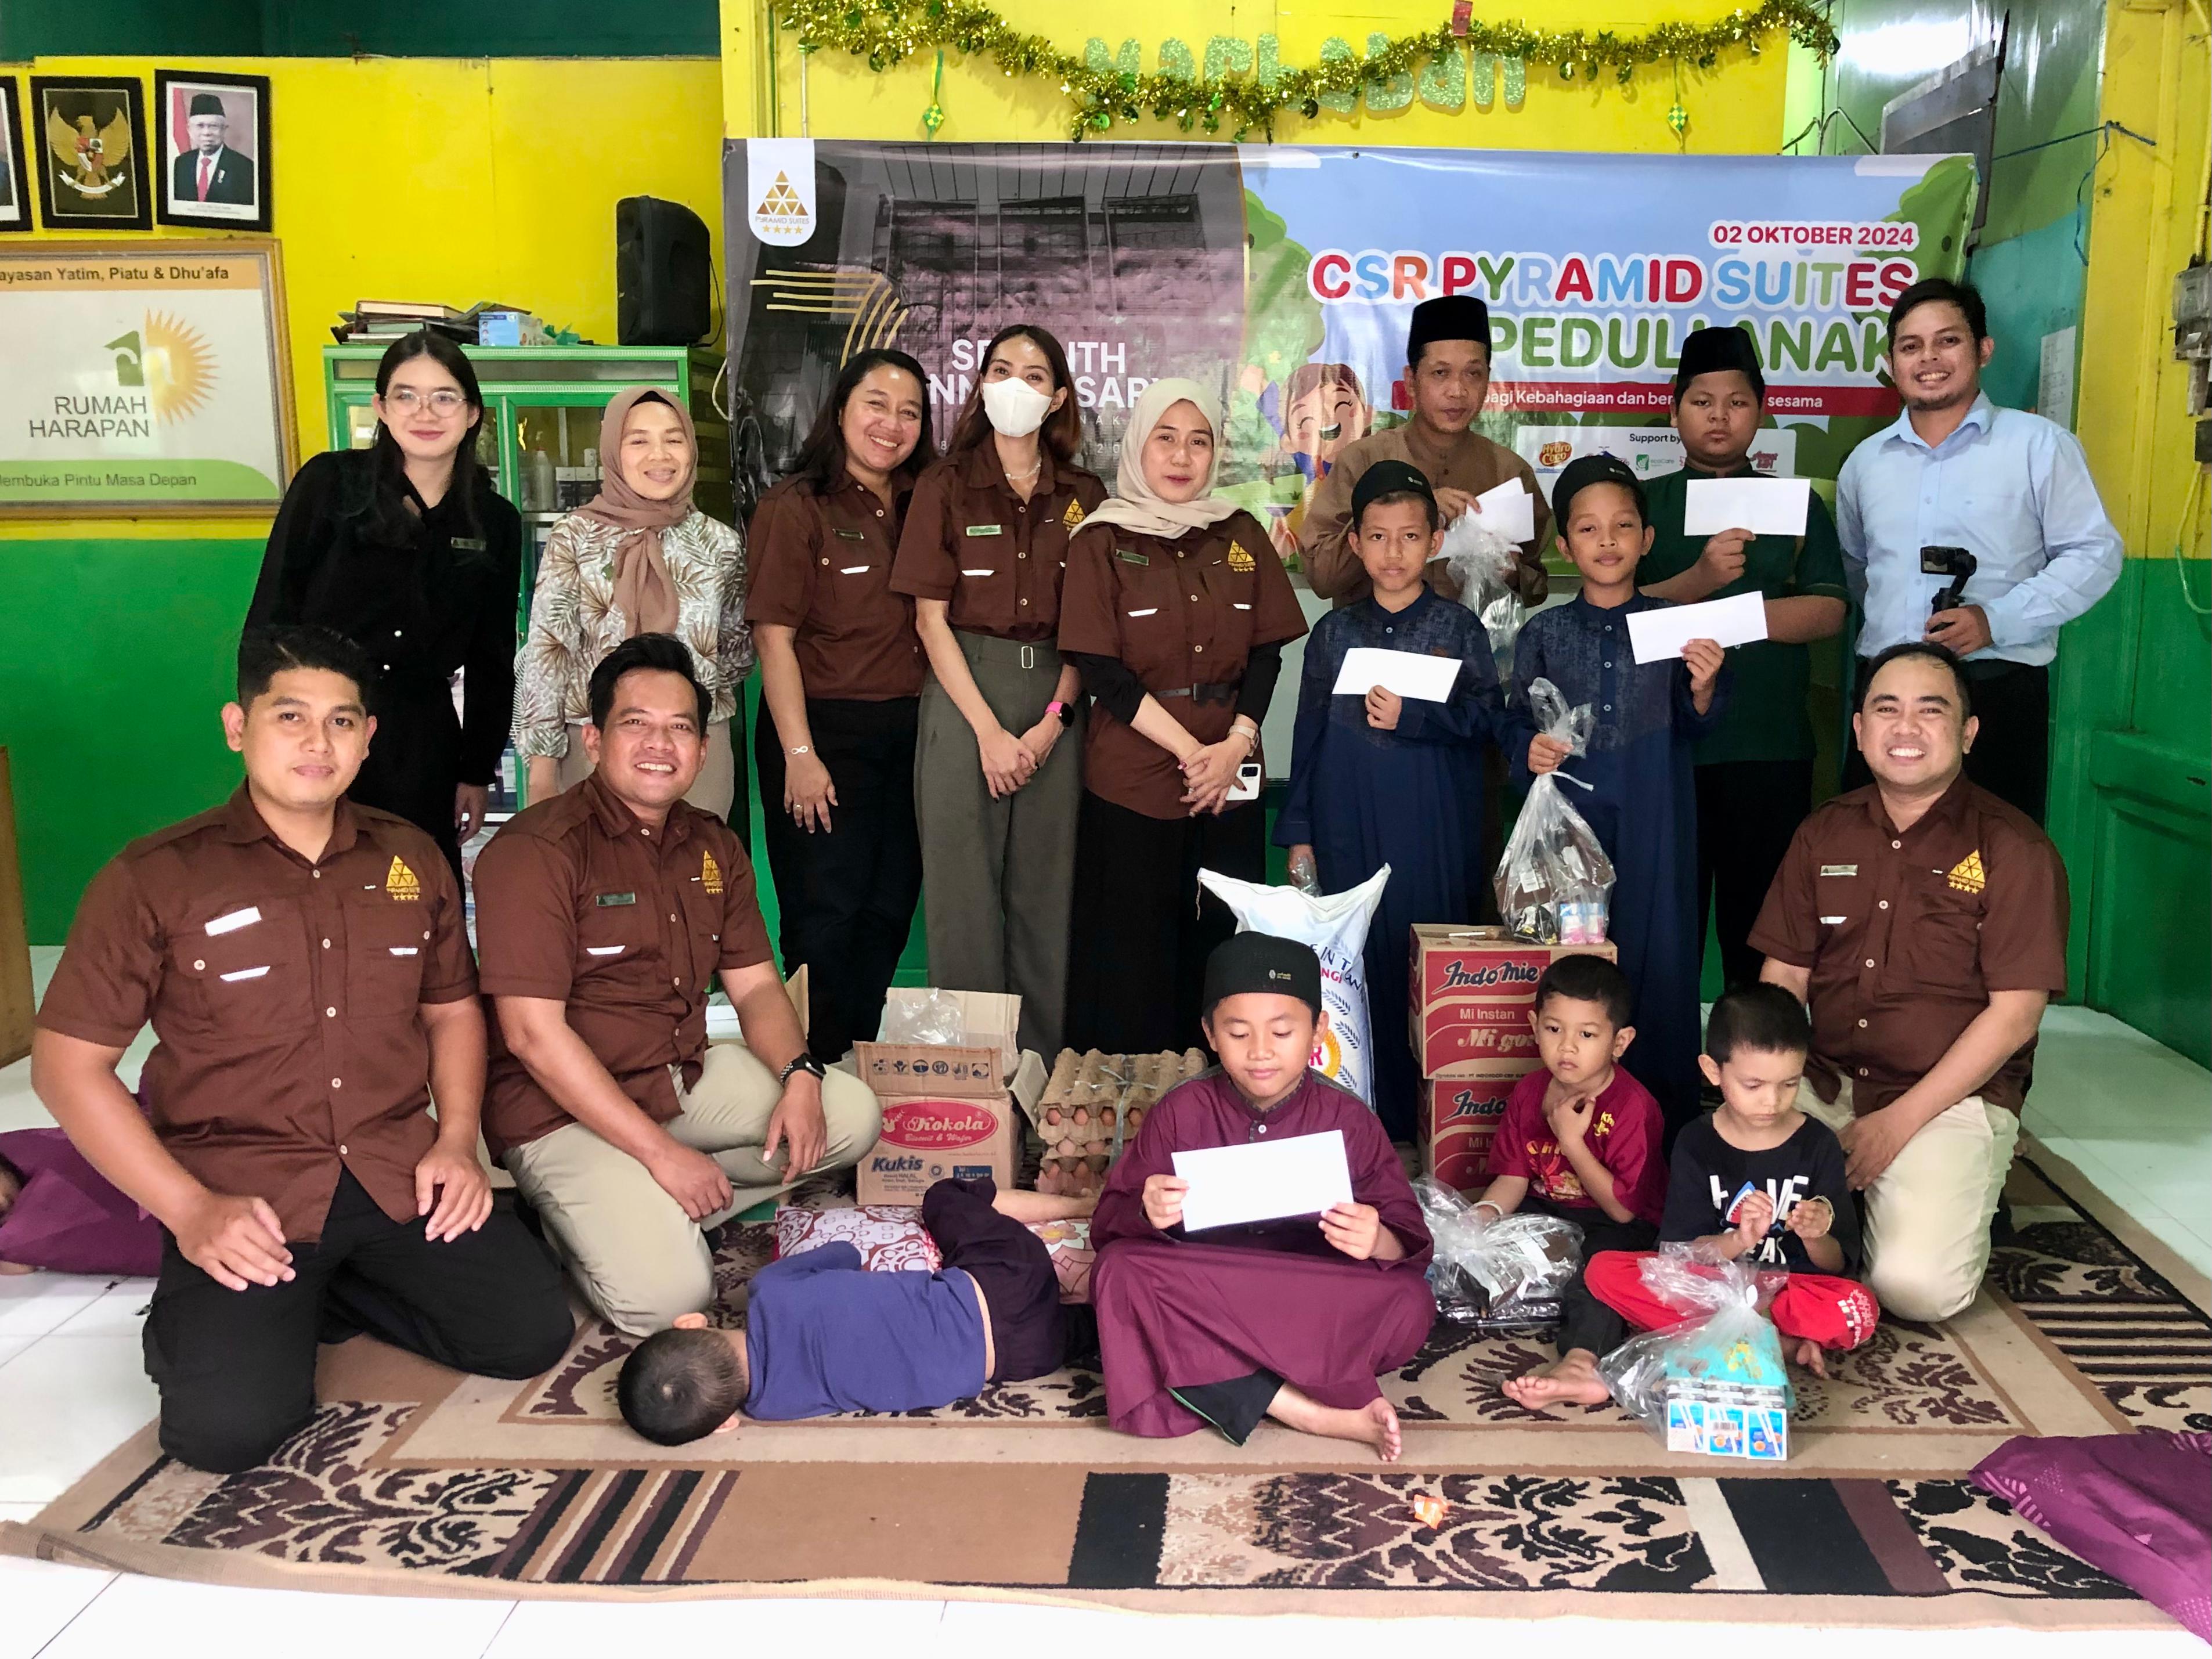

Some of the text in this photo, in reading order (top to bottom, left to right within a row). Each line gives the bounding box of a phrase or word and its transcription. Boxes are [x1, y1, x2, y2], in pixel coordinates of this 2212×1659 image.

[1713, 225, 1914, 246] 02 OKTOBER 2024
[0, 269, 52, 283] ayasan
[57, 268, 104, 282] Yatim,
[110, 267, 149, 280] Piatu
[153, 266, 164, 279] &
[1312, 255, 1913, 307] CSR PYRAMID SUITES
[1489, 317, 1705, 368] PEDUL
[54, 396, 147, 414] RUMAH
[1516, 390, 1614, 407] Kebahagiaan
[1617, 391, 1644, 405] dan
[1767, 396, 1823, 407] sesama
[30, 419, 150, 438] HARAPAN
[1629, 434, 1681, 444] Support by
[1543, 443, 1571, 455] Hydro
[1542, 452, 1567, 465] Coco
[0, 473, 196, 487] embuka Pintu Masa Depan
[1460, 1008, 1515, 1020] Mi Instan
[907, 1115, 986, 1132] Kokola
[872, 1155, 924, 1172] Kukis
